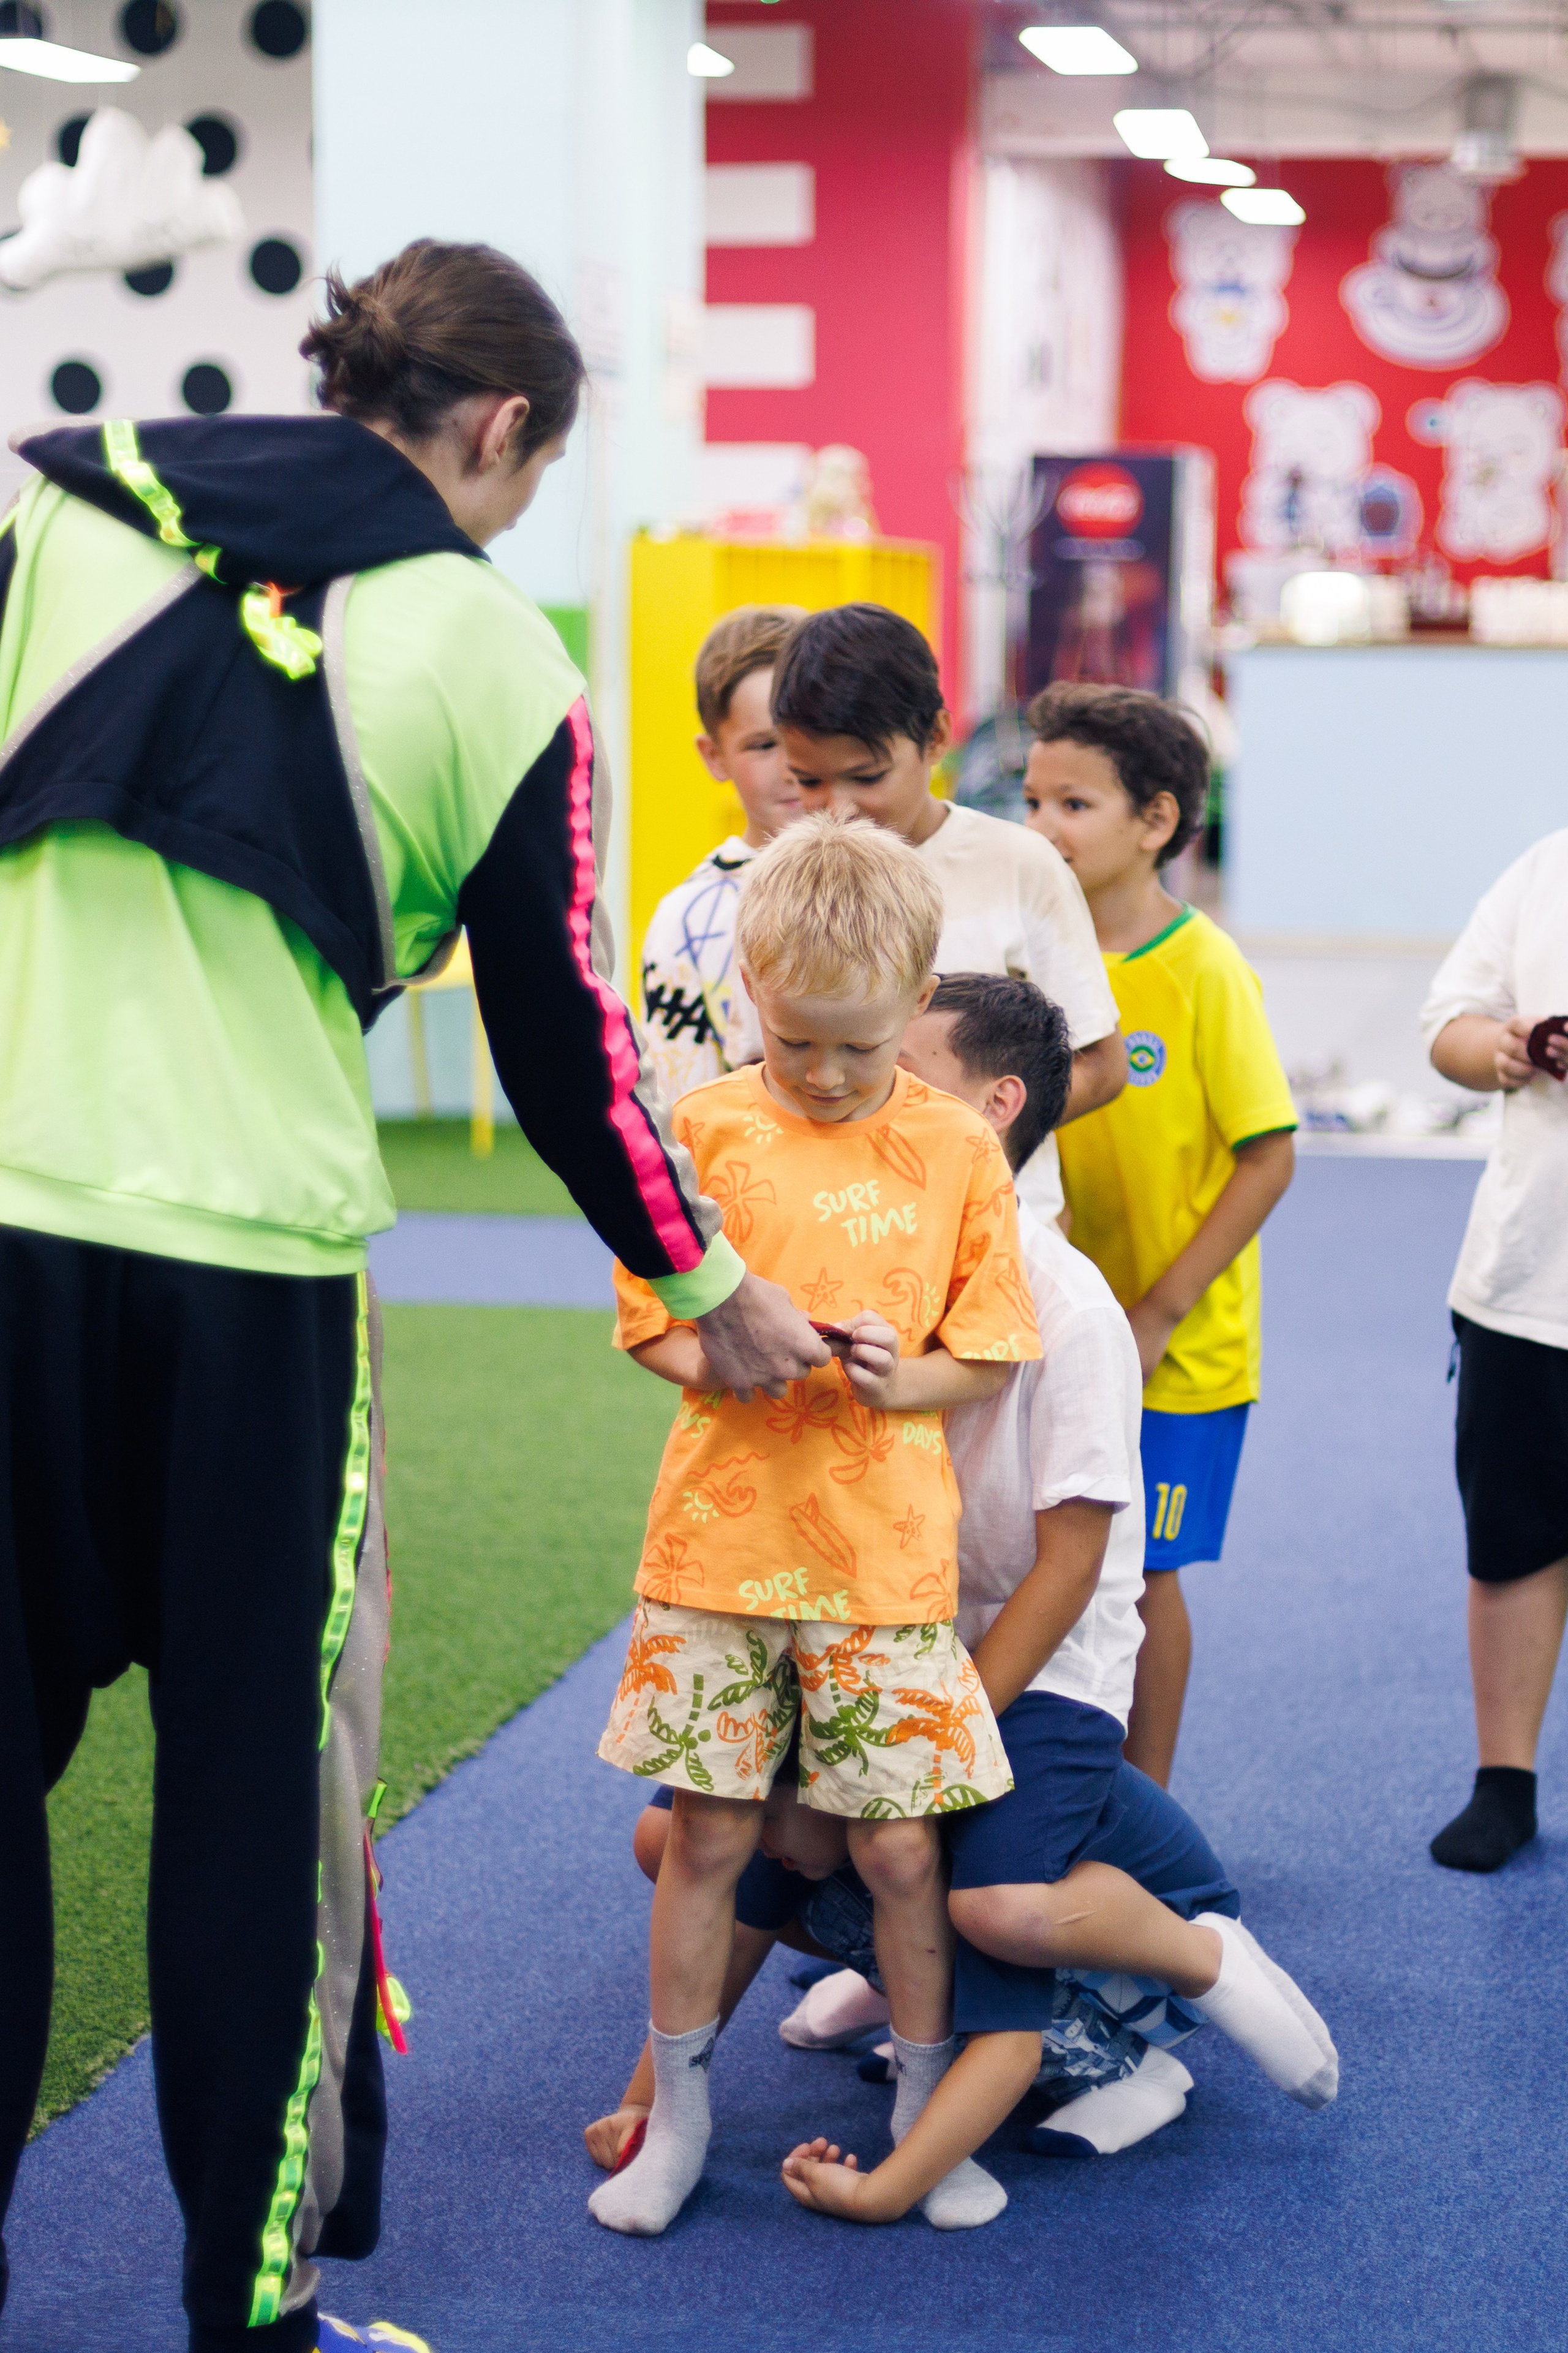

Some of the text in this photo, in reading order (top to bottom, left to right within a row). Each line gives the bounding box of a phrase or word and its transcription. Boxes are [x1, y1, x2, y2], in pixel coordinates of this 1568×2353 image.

[813, 1179, 880, 1222] SURF
[841, 1202, 918, 1247] TIME
[902, 1421, 942, 1456] DAYS
[1152, 1482, 1188, 1541] 10
[739, 1566, 809, 1611] SURF
